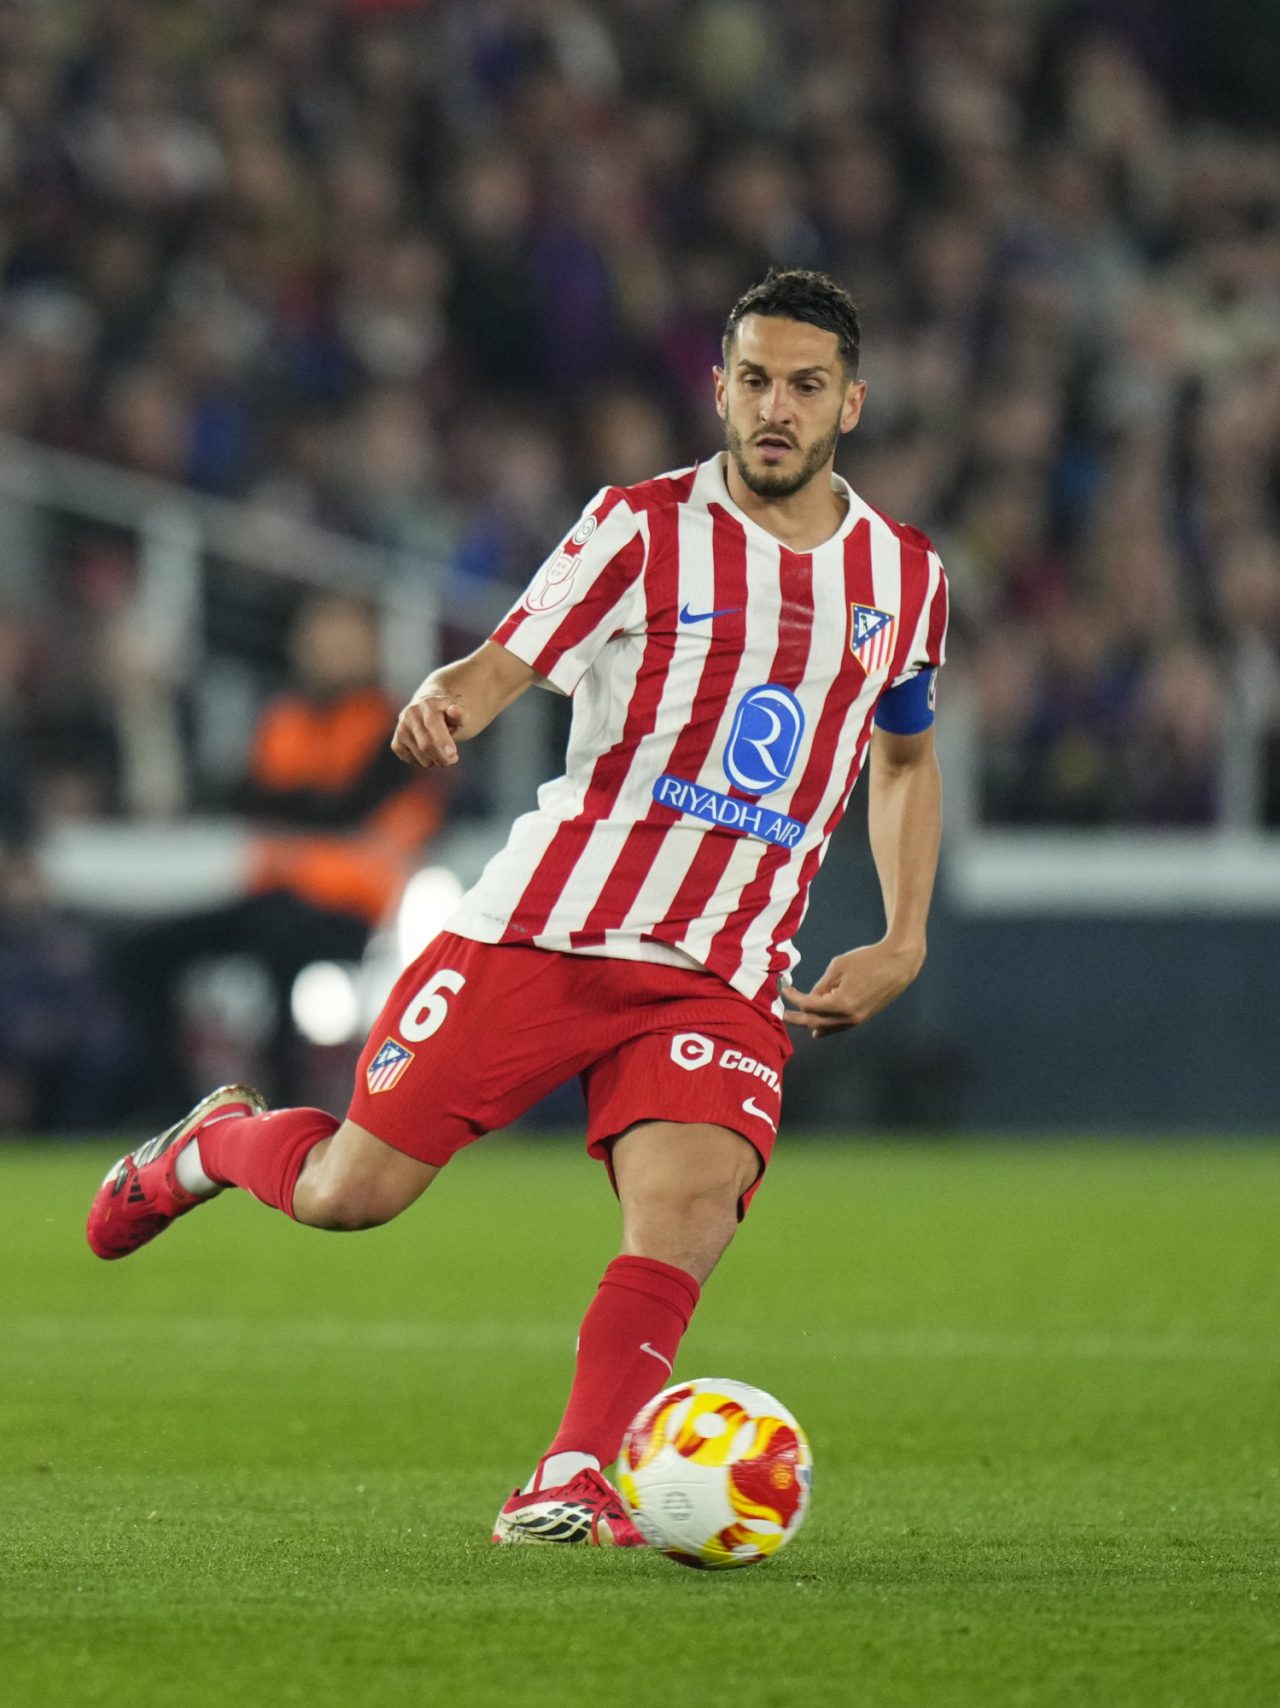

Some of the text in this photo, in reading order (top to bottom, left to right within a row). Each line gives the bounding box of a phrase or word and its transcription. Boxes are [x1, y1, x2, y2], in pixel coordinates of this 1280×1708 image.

[659, 778, 801, 847] RIYADH AIR
[399, 969, 466, 1042] 6
